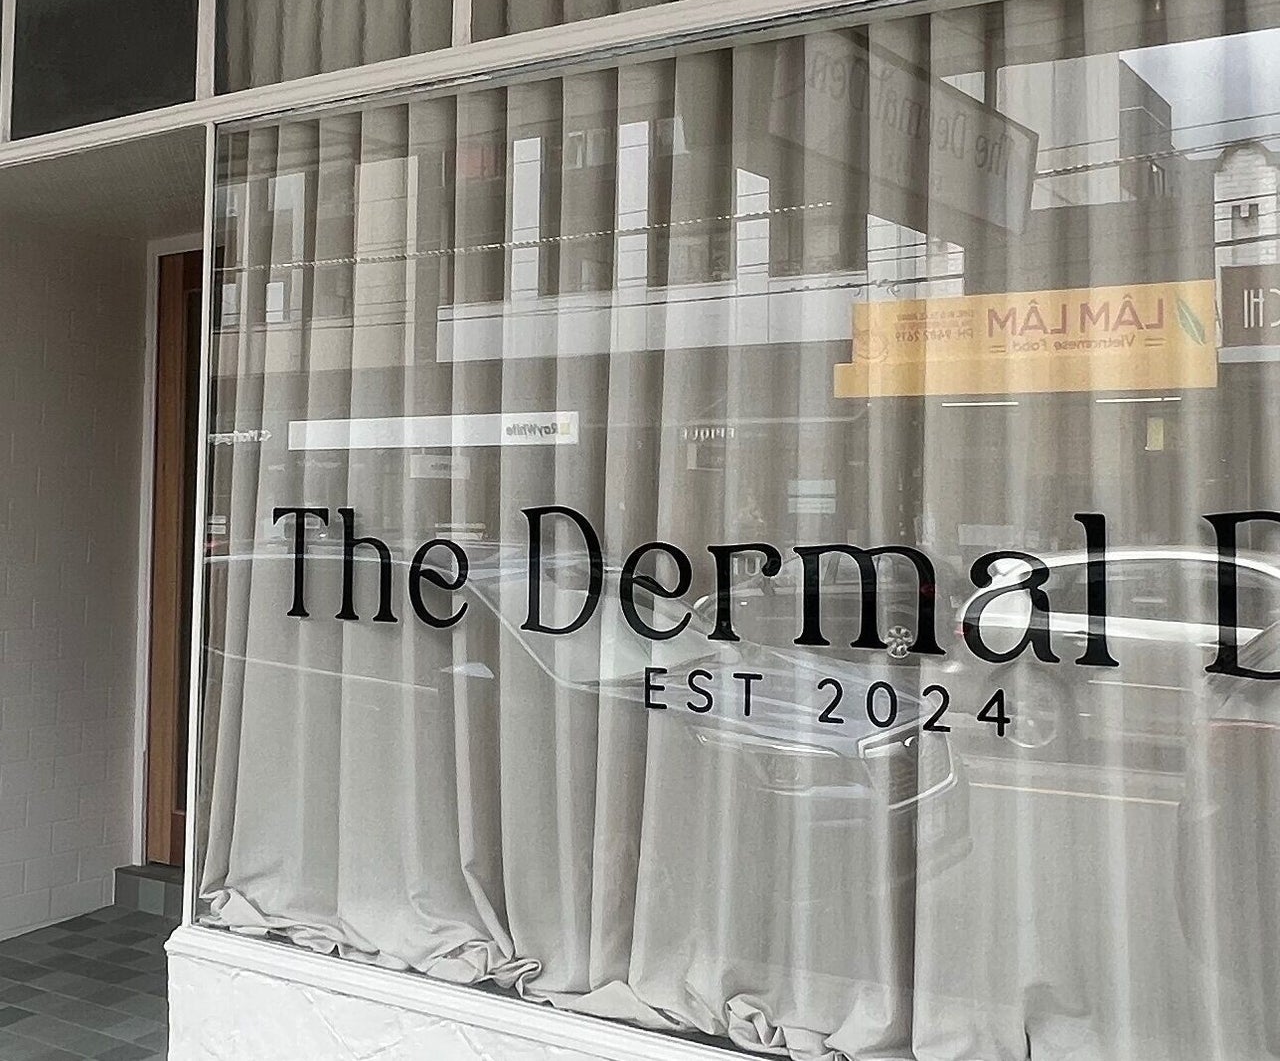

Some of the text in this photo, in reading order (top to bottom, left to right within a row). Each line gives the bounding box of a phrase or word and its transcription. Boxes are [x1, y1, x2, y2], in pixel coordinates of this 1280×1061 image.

[271, 504, 470, 631] The
[519, 504, 1121, 669] Dermal
[643, 666, 1012, 738] EST 2024
